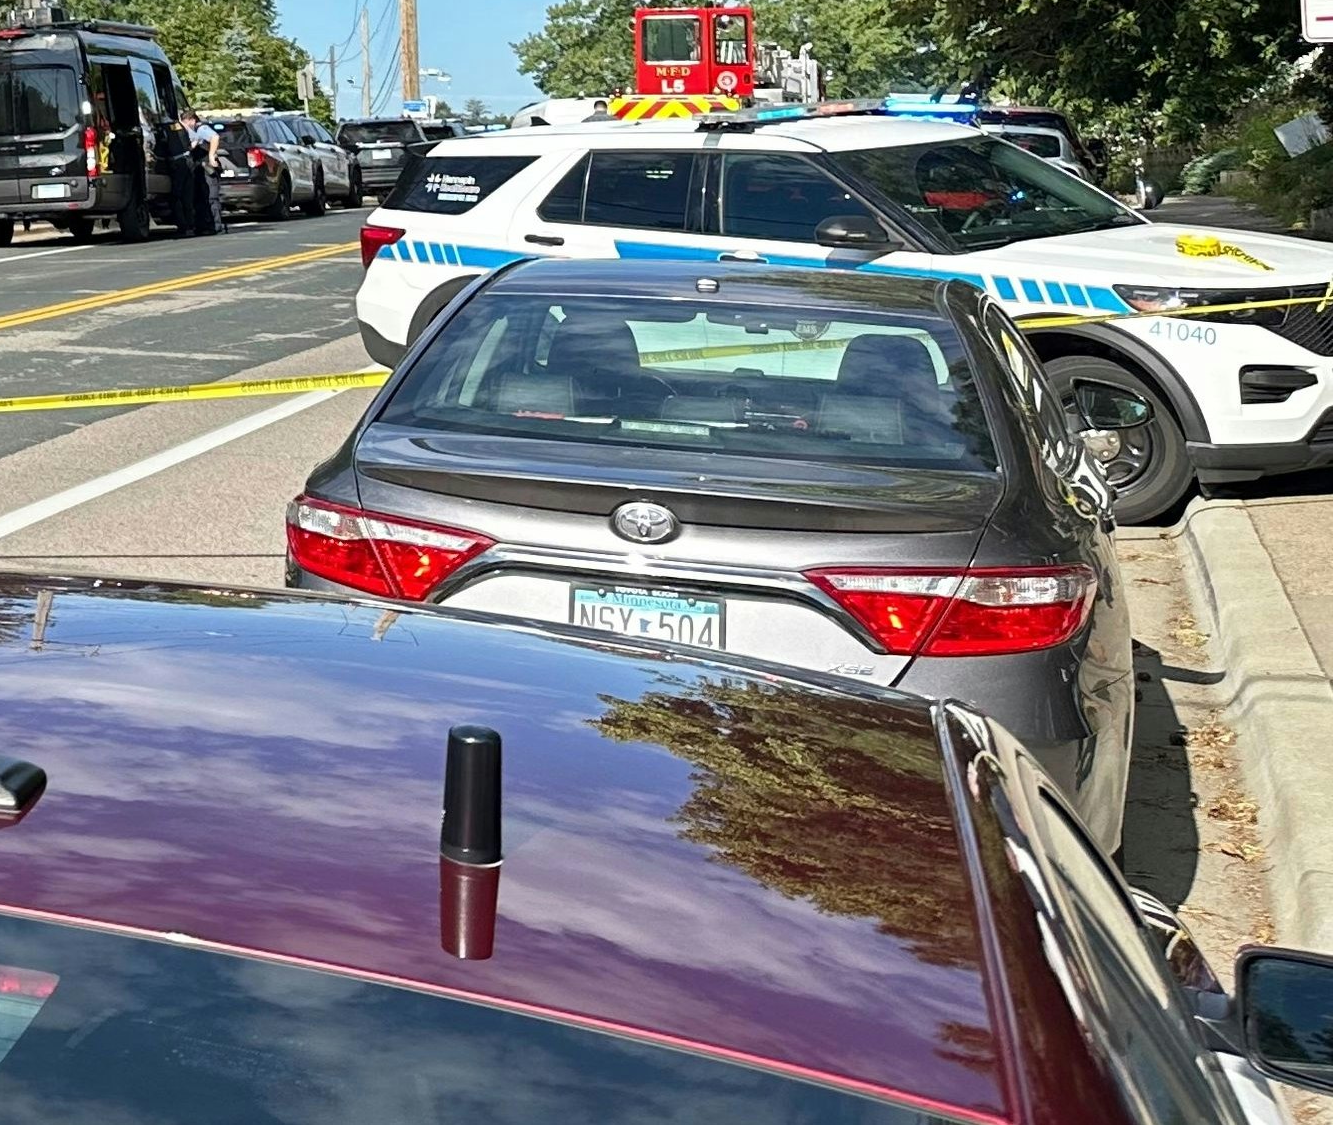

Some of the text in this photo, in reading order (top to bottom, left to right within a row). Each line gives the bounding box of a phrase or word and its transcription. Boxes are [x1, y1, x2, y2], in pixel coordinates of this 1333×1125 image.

[661, 78, 686, 94] L5
[1148, 320, 1217, 346] 41040
[612, 593, 682, 610] Minnesota
[579, 604, 714, 648] NSY 504
